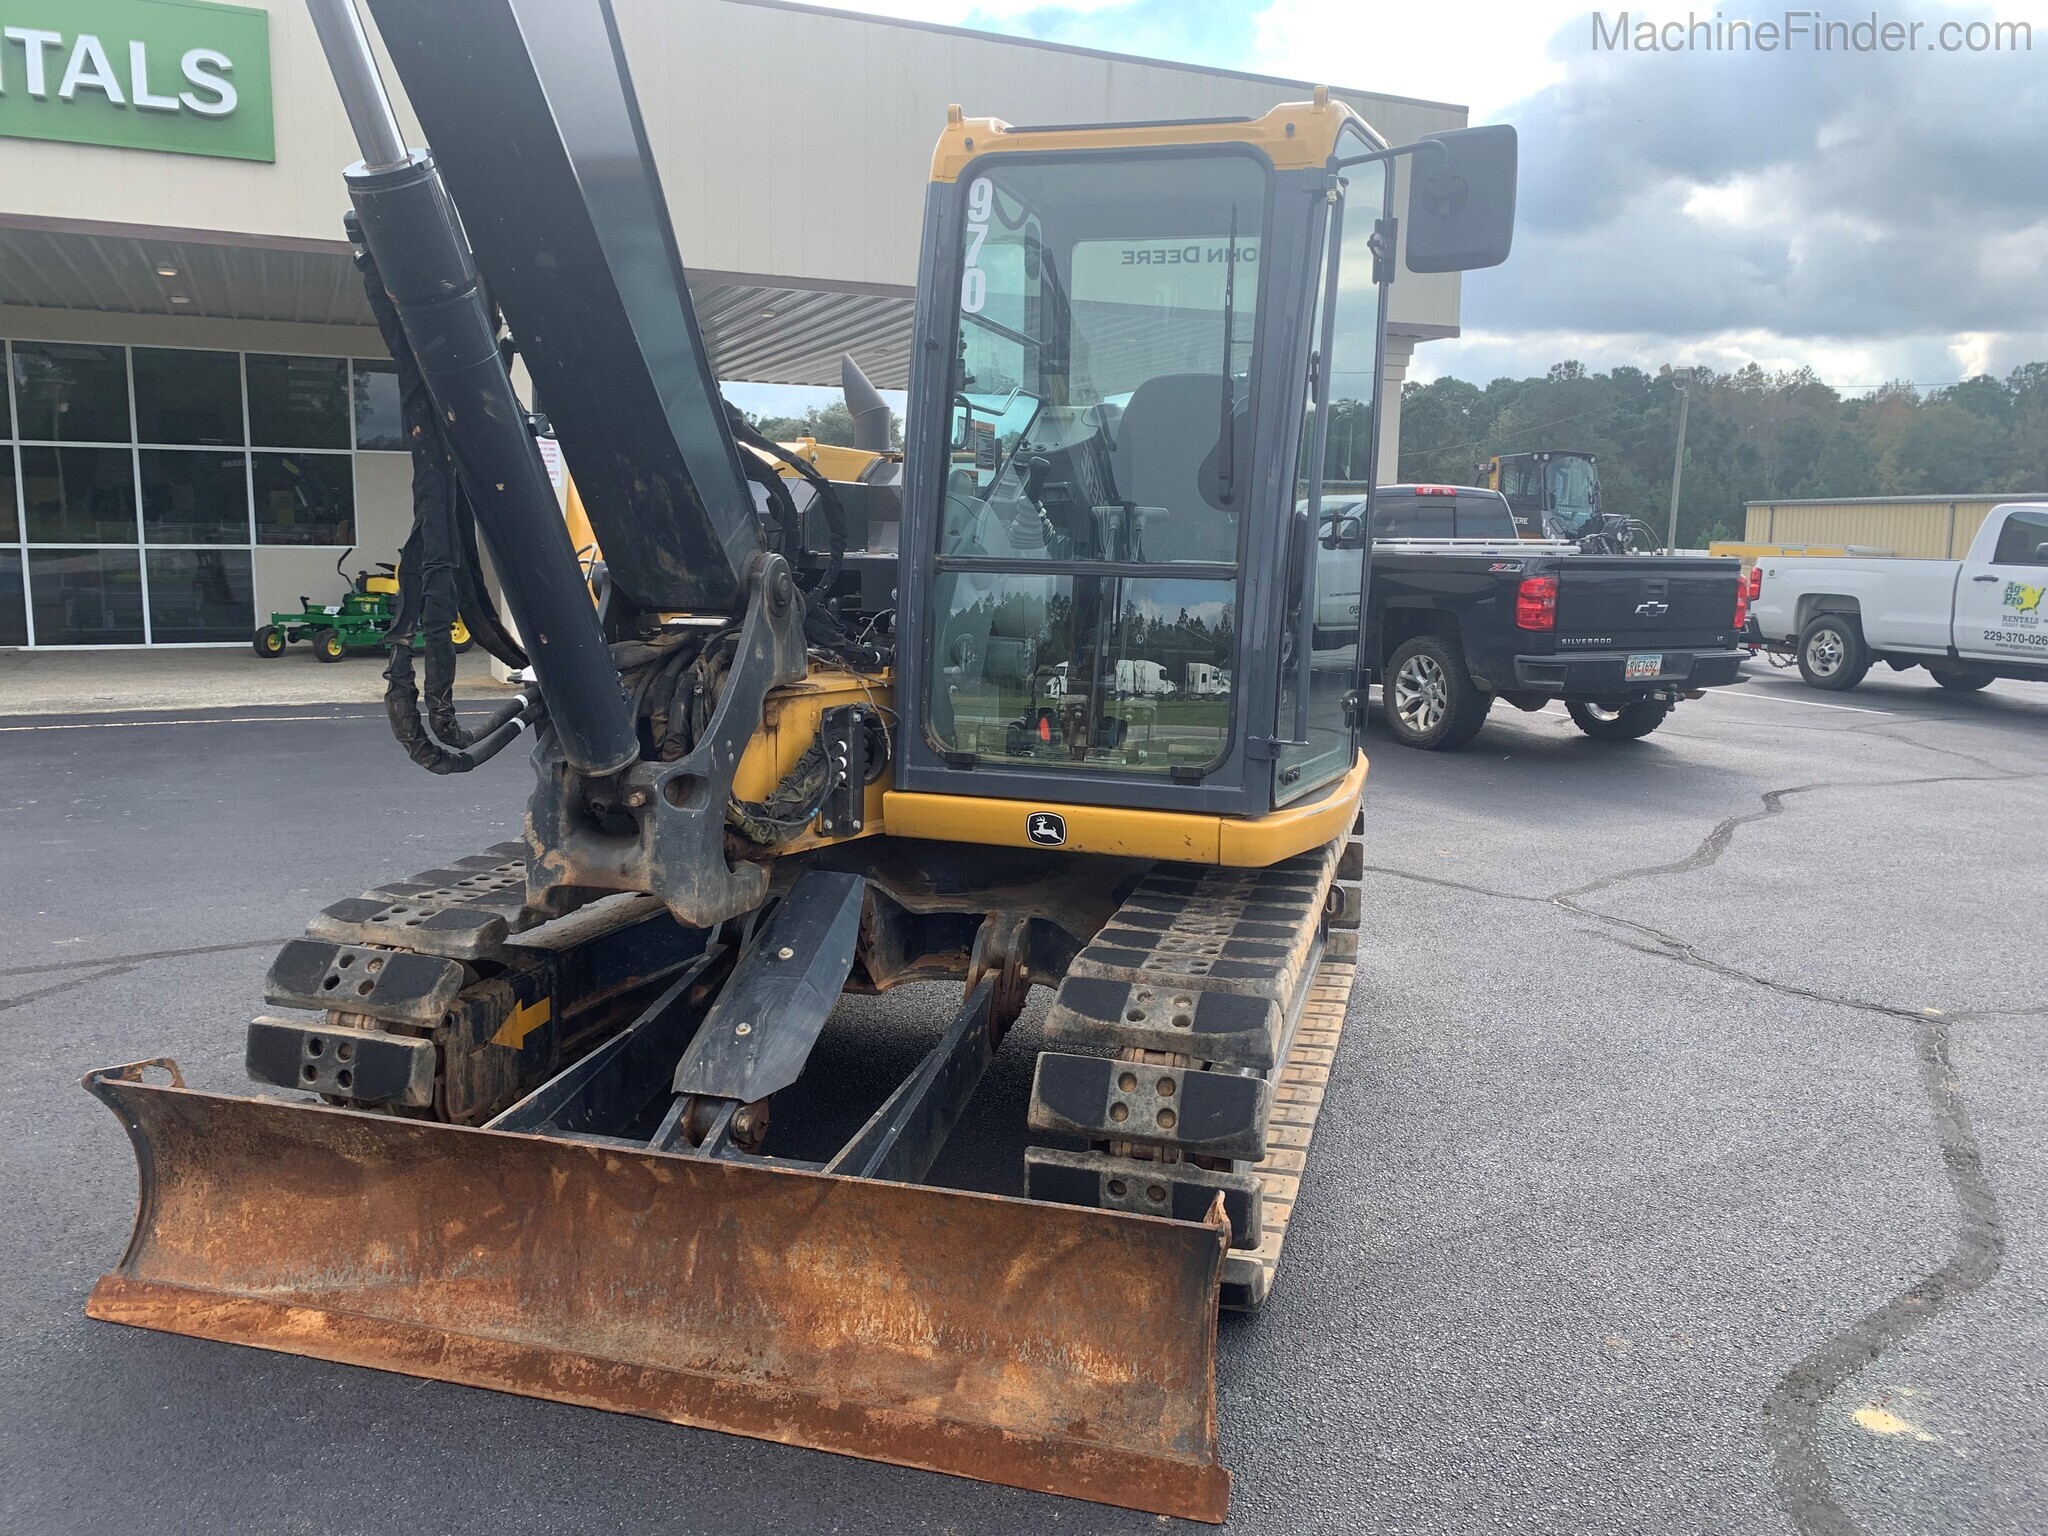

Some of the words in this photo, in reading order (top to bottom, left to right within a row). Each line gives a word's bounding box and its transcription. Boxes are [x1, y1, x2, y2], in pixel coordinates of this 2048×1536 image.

[0, 25, 238, 117] TALS
[961, 177, 993, 313] 970
[1512, 516, 1529, 525] ERE
[2003, 593, 2024, 605] Pro
[2002, 615, 2040, 625] RENTALS
[1561, 637, 1612, 645] SILVERADO
[1983, 630, 2048, 646] 229-370-026
[1629, 660, 1658, 672] RVE7692
